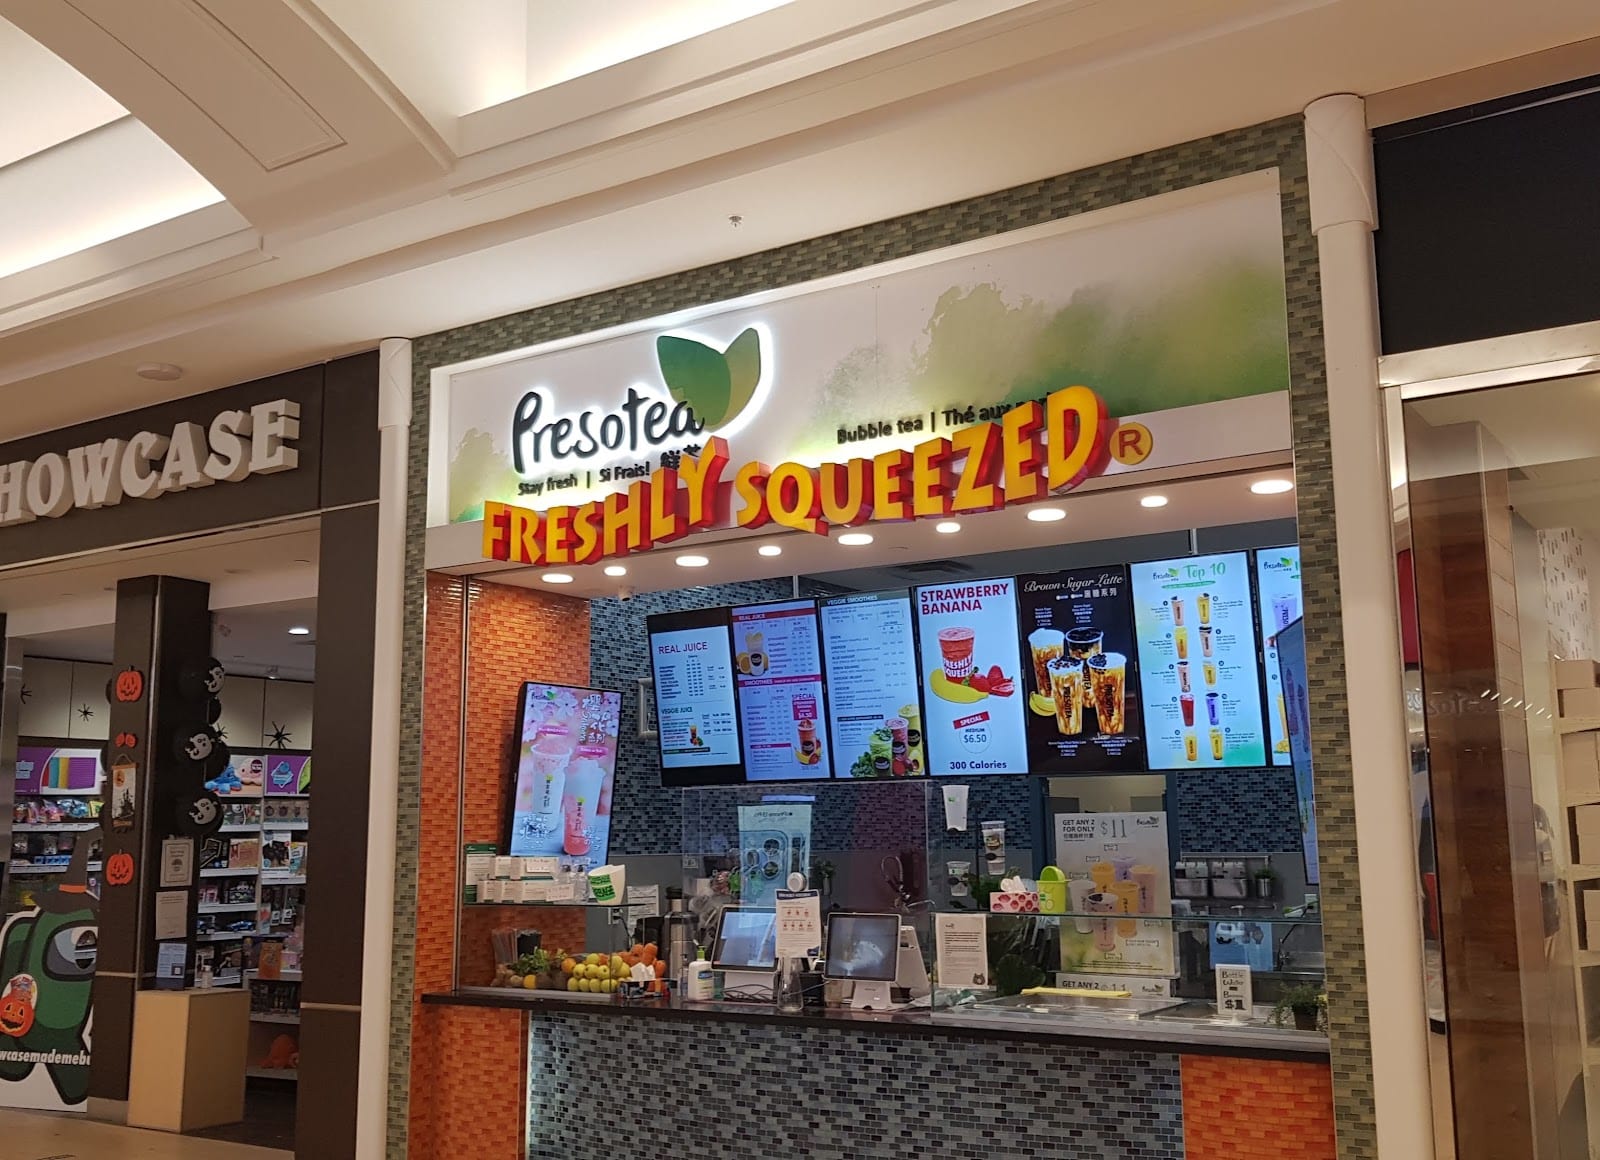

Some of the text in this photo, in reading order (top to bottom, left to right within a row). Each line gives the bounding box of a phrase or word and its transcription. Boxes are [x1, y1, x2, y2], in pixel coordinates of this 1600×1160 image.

[942, 406, 975, 426] Thé
[512, 388, 704, 473] Presotea
[837, 416, 923, 444] Bubble tea
[482, 436, 730, 565] FRESHLY
[736, 386, 1110, 537] SQUEEZED
[600, 461, 650, 483] Si Frais!
[518, 473, 577, 496] Stay fresh
[1183, 562, 1226, 580] Top 10
[1024, 574, 1122, 592] Brown Sugar Latte
[847, 595, 878, 603] SMOOTHIES
[921, 583, 1009, 603] STRAWBERRY
[922, 600, 982, 615] BANANA
[658, 642, 708, 654] REAL JUICE
[960, 714, 983, 727] SPECIAL
[963, 734, 987, 744] $6.50
[950, 760, 1007, 770] 300 Calories
[1062, 980, 1076, 988] GET
